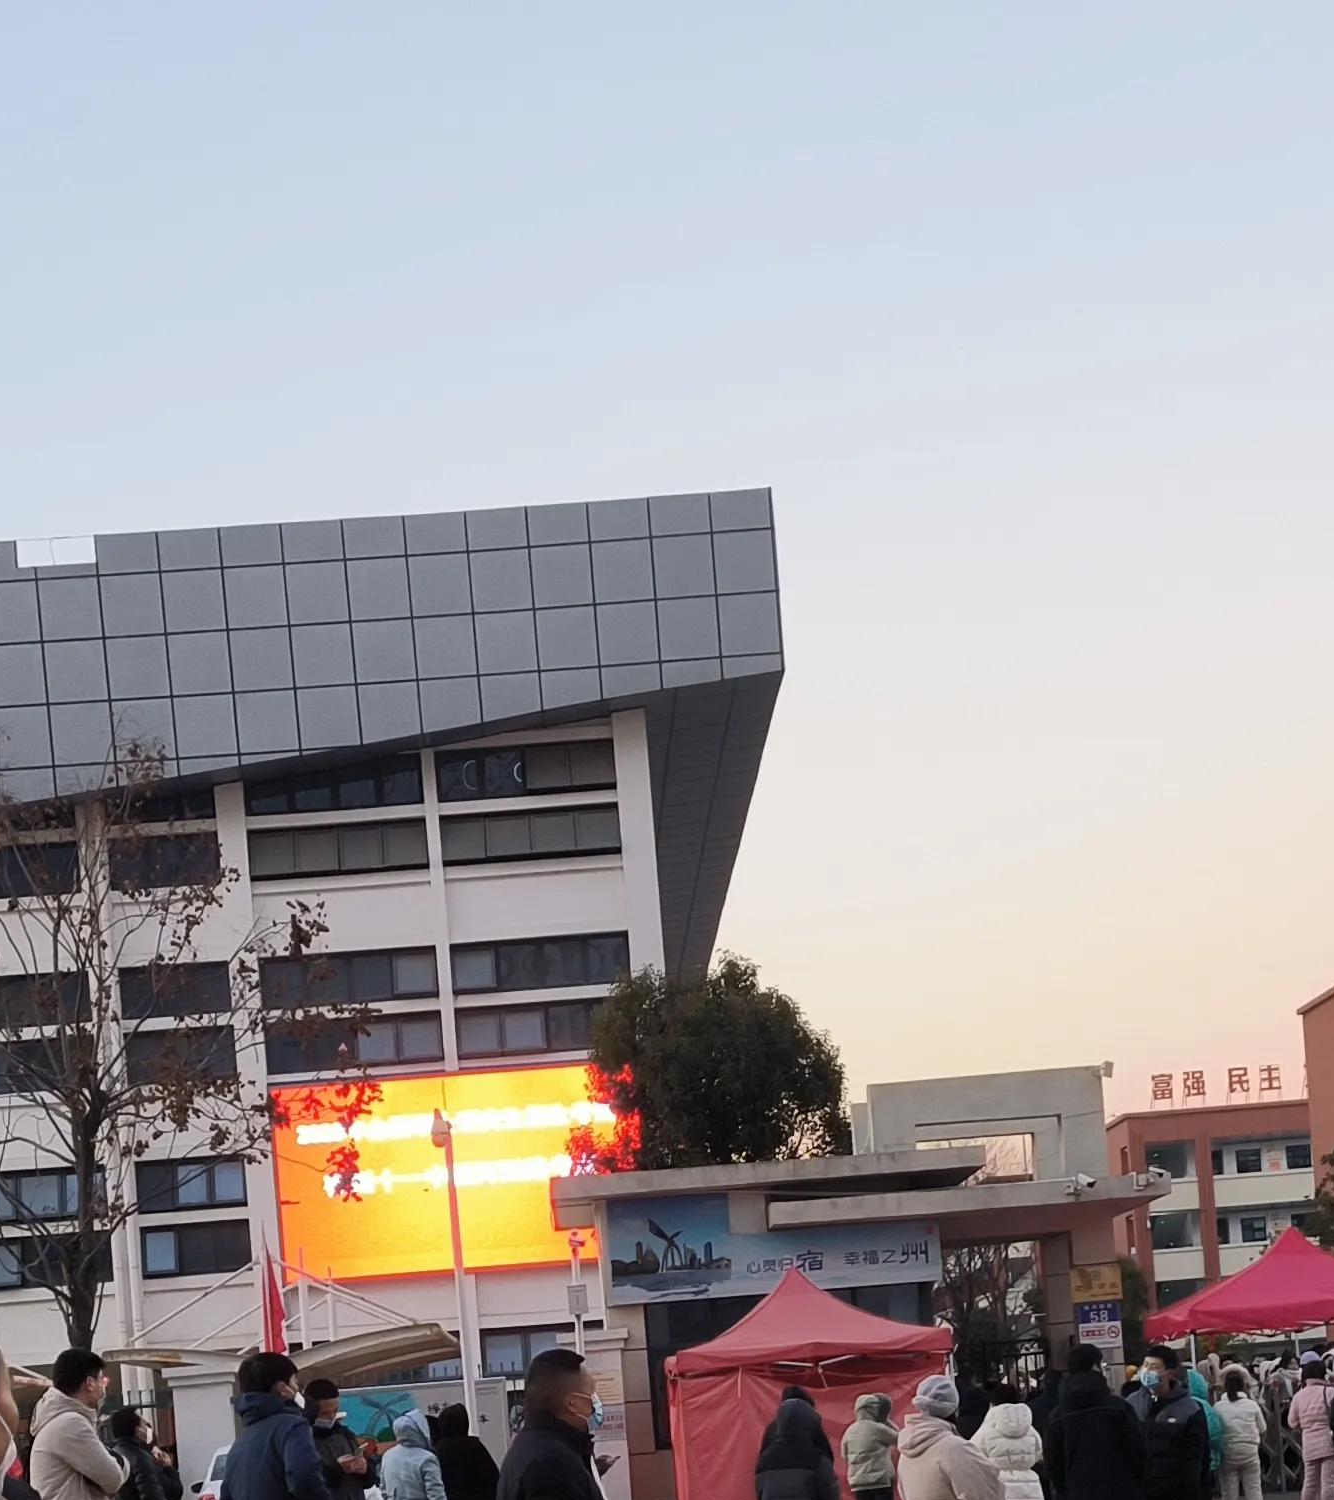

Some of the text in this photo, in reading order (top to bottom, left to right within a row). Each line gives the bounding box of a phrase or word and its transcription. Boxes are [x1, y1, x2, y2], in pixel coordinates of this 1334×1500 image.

[1151, 1064, 1282, 1101] 富强 民主
[746, 1240, 929, 1275] 心灵归宿 幸福之州
[1089, 1309, 1109, 1324] 58
